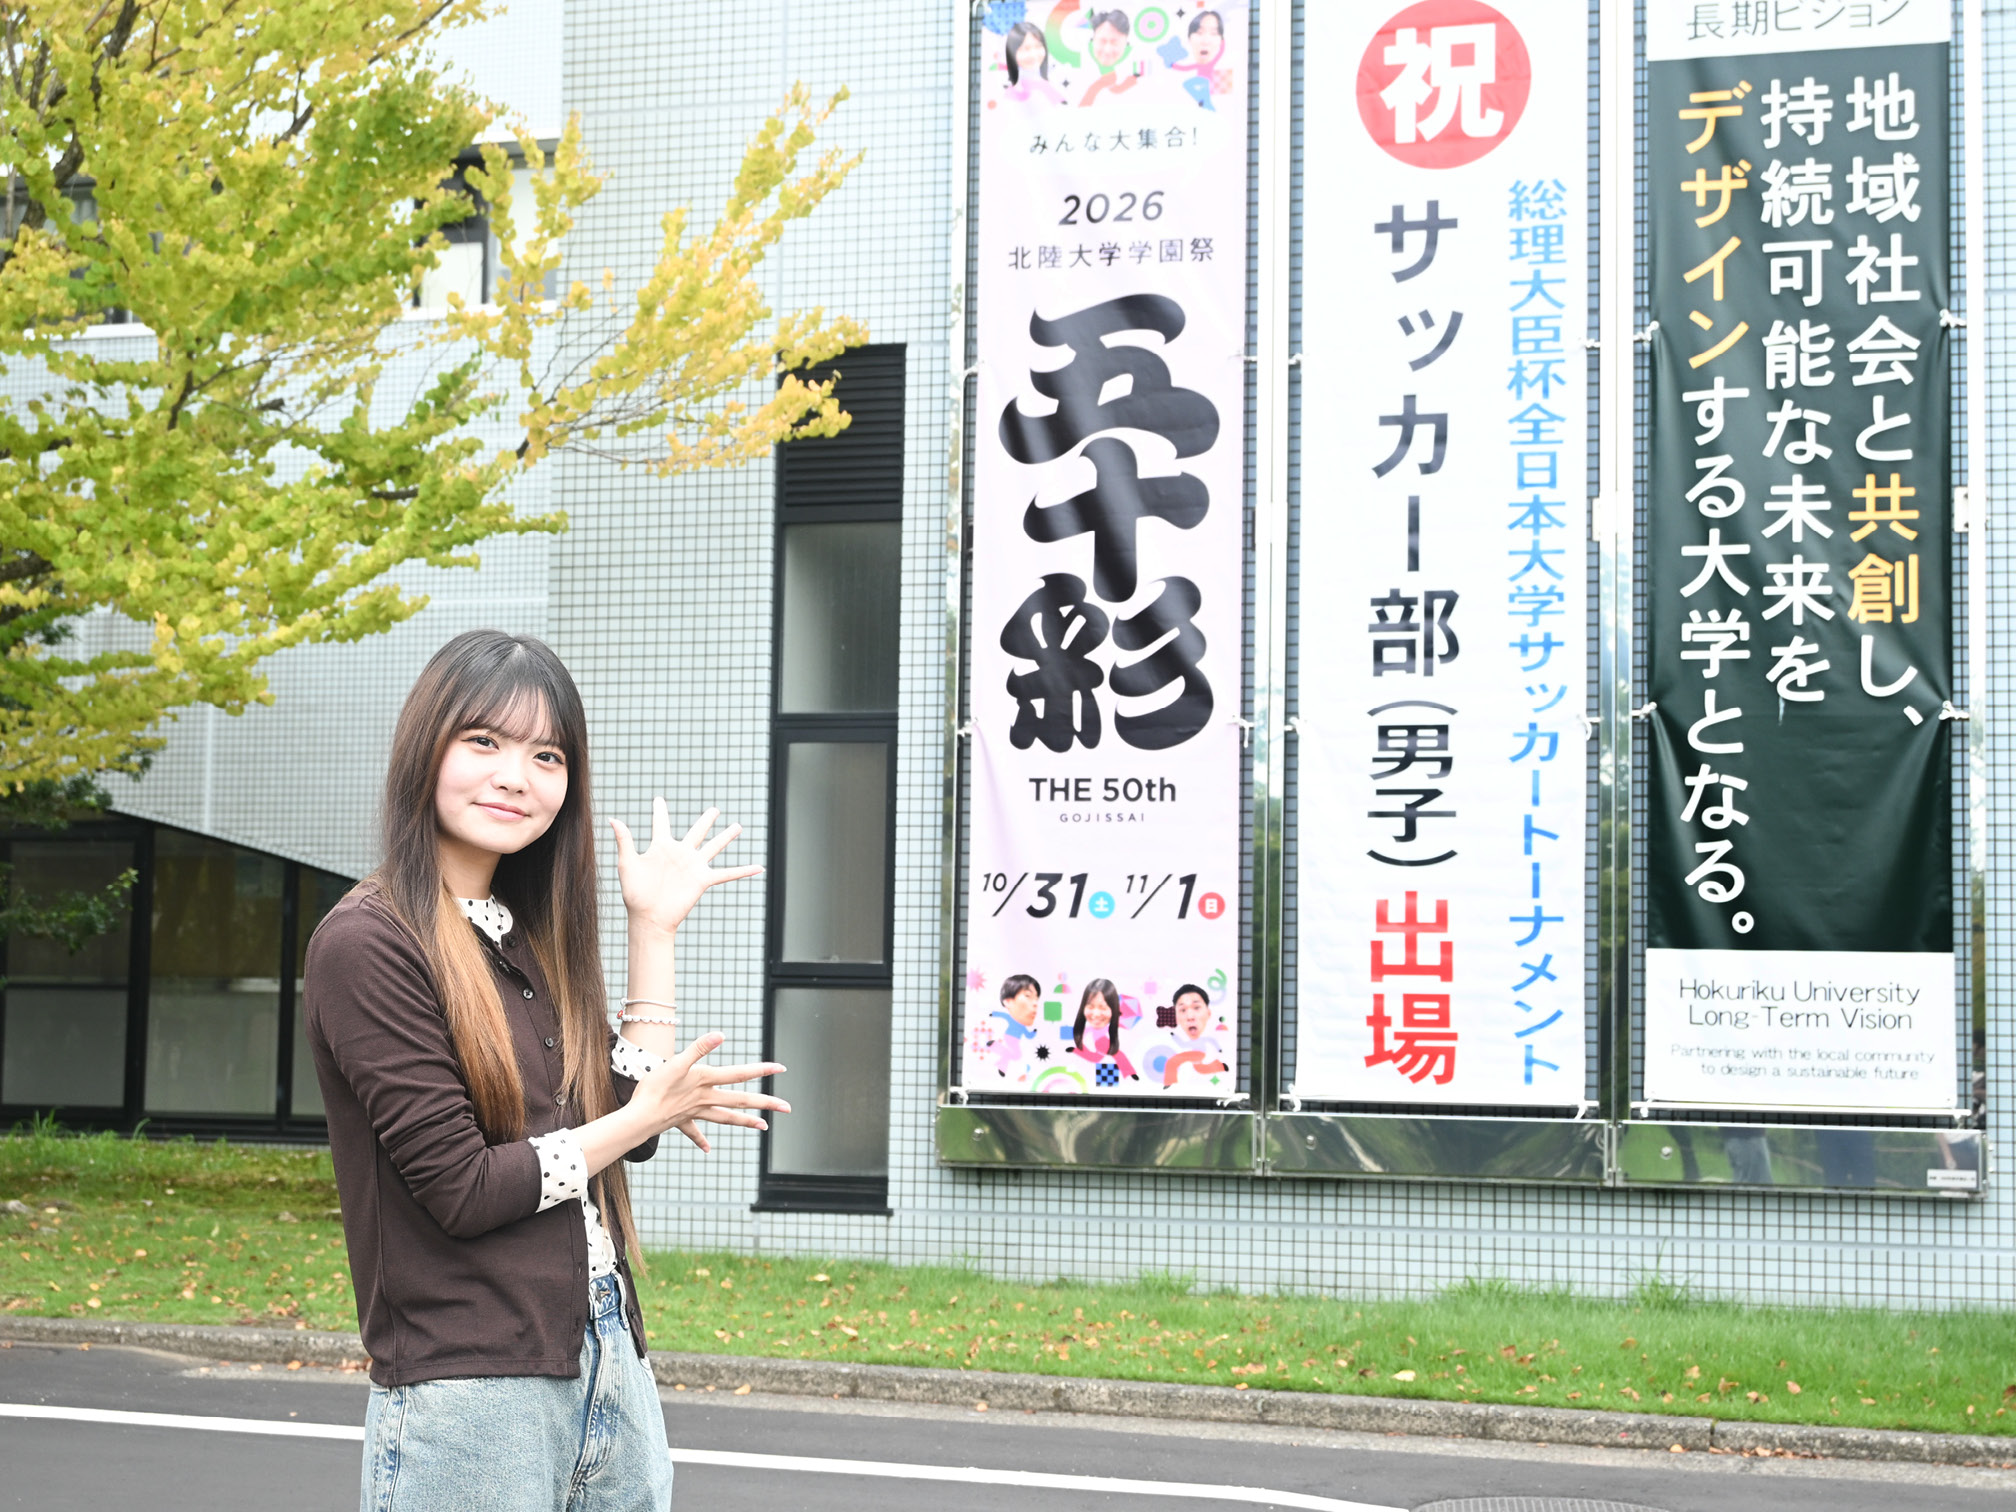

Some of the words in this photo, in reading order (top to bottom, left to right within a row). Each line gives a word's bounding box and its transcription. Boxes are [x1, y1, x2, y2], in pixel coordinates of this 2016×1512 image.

[1379, 22, 1505, 144] 祝
[1030, 126, 1197, 154] みんな大集合!
[1058, 190, 1165, 226] 2026
[1008, 237, 1214, 270] 北陸大学学園祭
[1760, 76, 1836, 702] 持続可能な未来を
[998, 293, 1220, 754] 五十彩
[1506, 178, 1568, 1086] 総理大臣杯全日本大学サッカートーナメント
[1028, 777, 1092, 802] THE
[1102, 776, 1176, 802] 50th
[1059, 813, 1145, 823] GOJISSAI
[1679, 978, 1785, 1002] Hokuriku
[1793, 980, 1921, 1007] University
[1689, 1004, 1830, 1030] Long-Term
[1840, 1007, 1912, 1030] Vision
[1671, 1043, 1746, 1061] Partnering
[1751, 1045, 1783, 1060] with
[1788, 1046, 1812, 1060] the
[1816, 1047, 1850, 1062] local
[1854, 1050, 1936, 1065] community
[1700, 1062, 1716, 1076] to
[1720, 1062, 1768, 1078] design
[1772, 1066, 1782, 1077] a
[1787, 1064, 1868, 1080] sustainable
[1874, 1065, 1920, 1081] future
